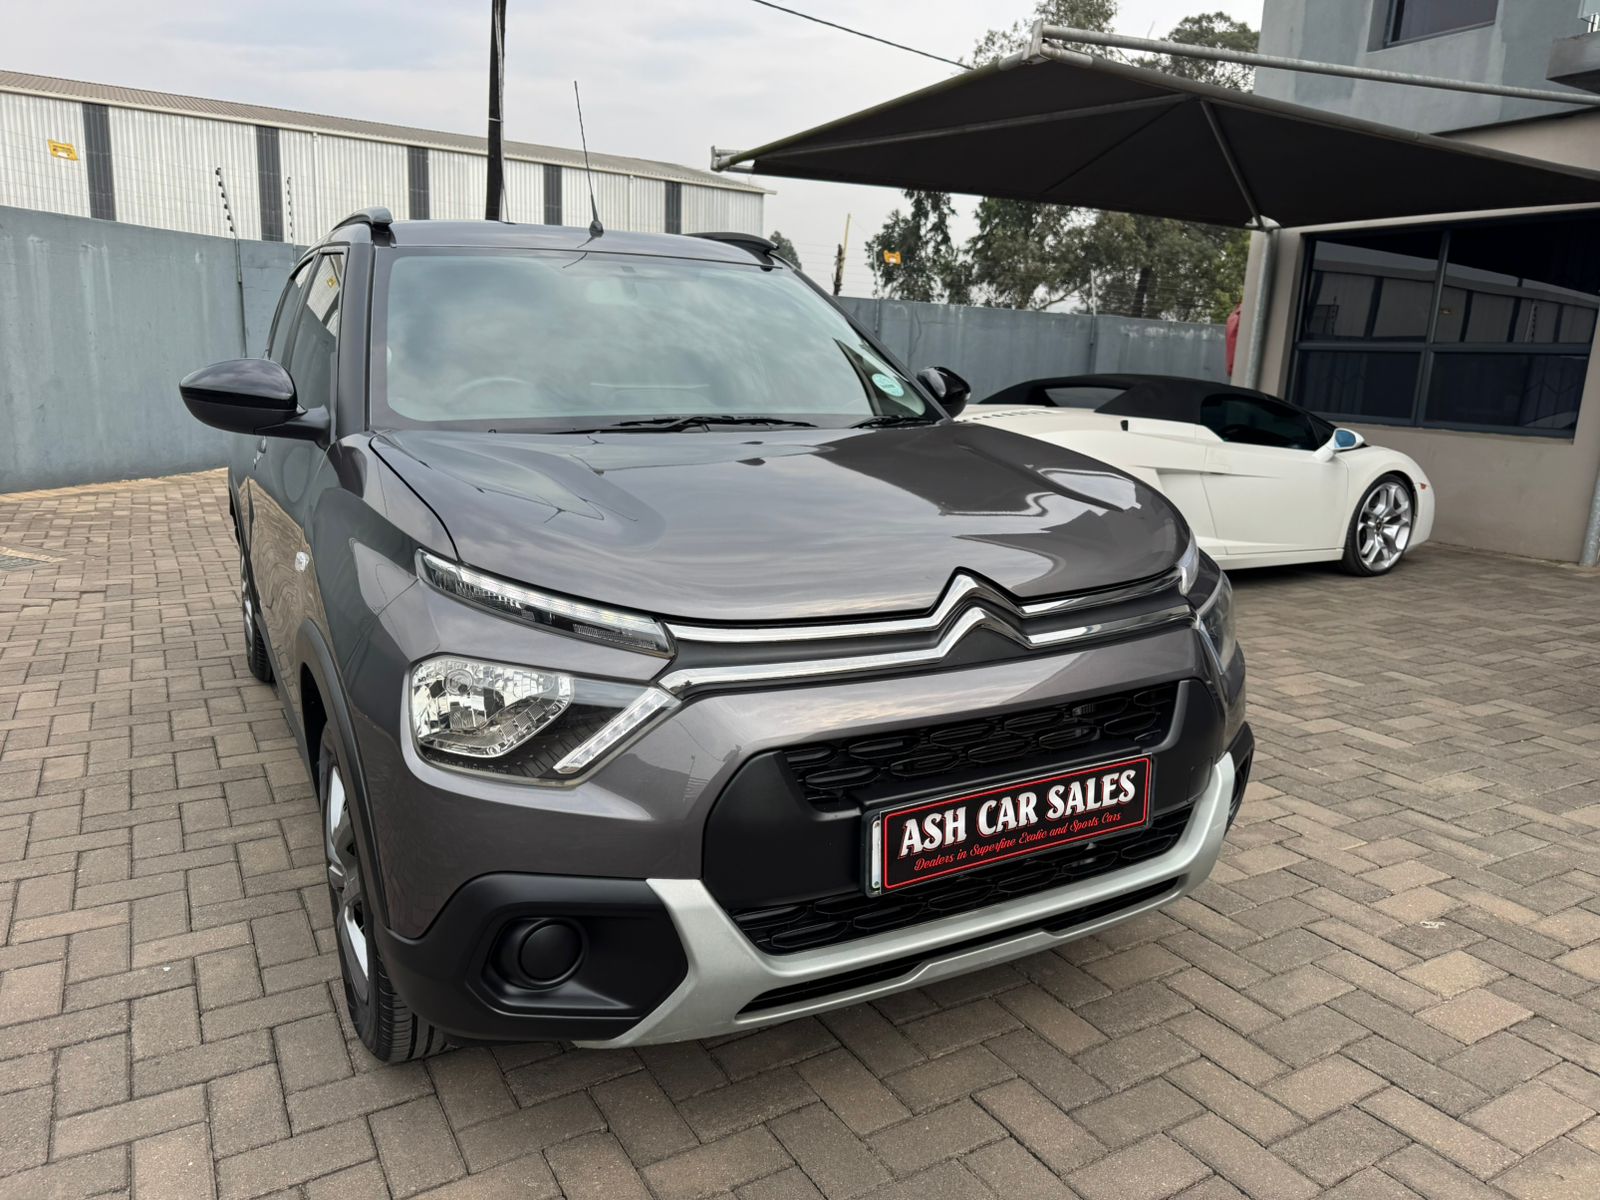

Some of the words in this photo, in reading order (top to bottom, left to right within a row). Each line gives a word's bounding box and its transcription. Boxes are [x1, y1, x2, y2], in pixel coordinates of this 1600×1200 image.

[898, 806, 968, 859] ASH
[976, 791, 1040, 838] CAR
[1045, 769, 1137, 821] SALES
[913, 853, 954, 871] Dealers
[956, 849, 968, 860] in
[969, 838, 1017, 857] Superfine
[1018, 827, 1048, 844] Exotic
[1049, 822, 1069, 837] and
[1069, 816, 1099, 833] Sports
[1101, 812, 1122, 824] Cars
